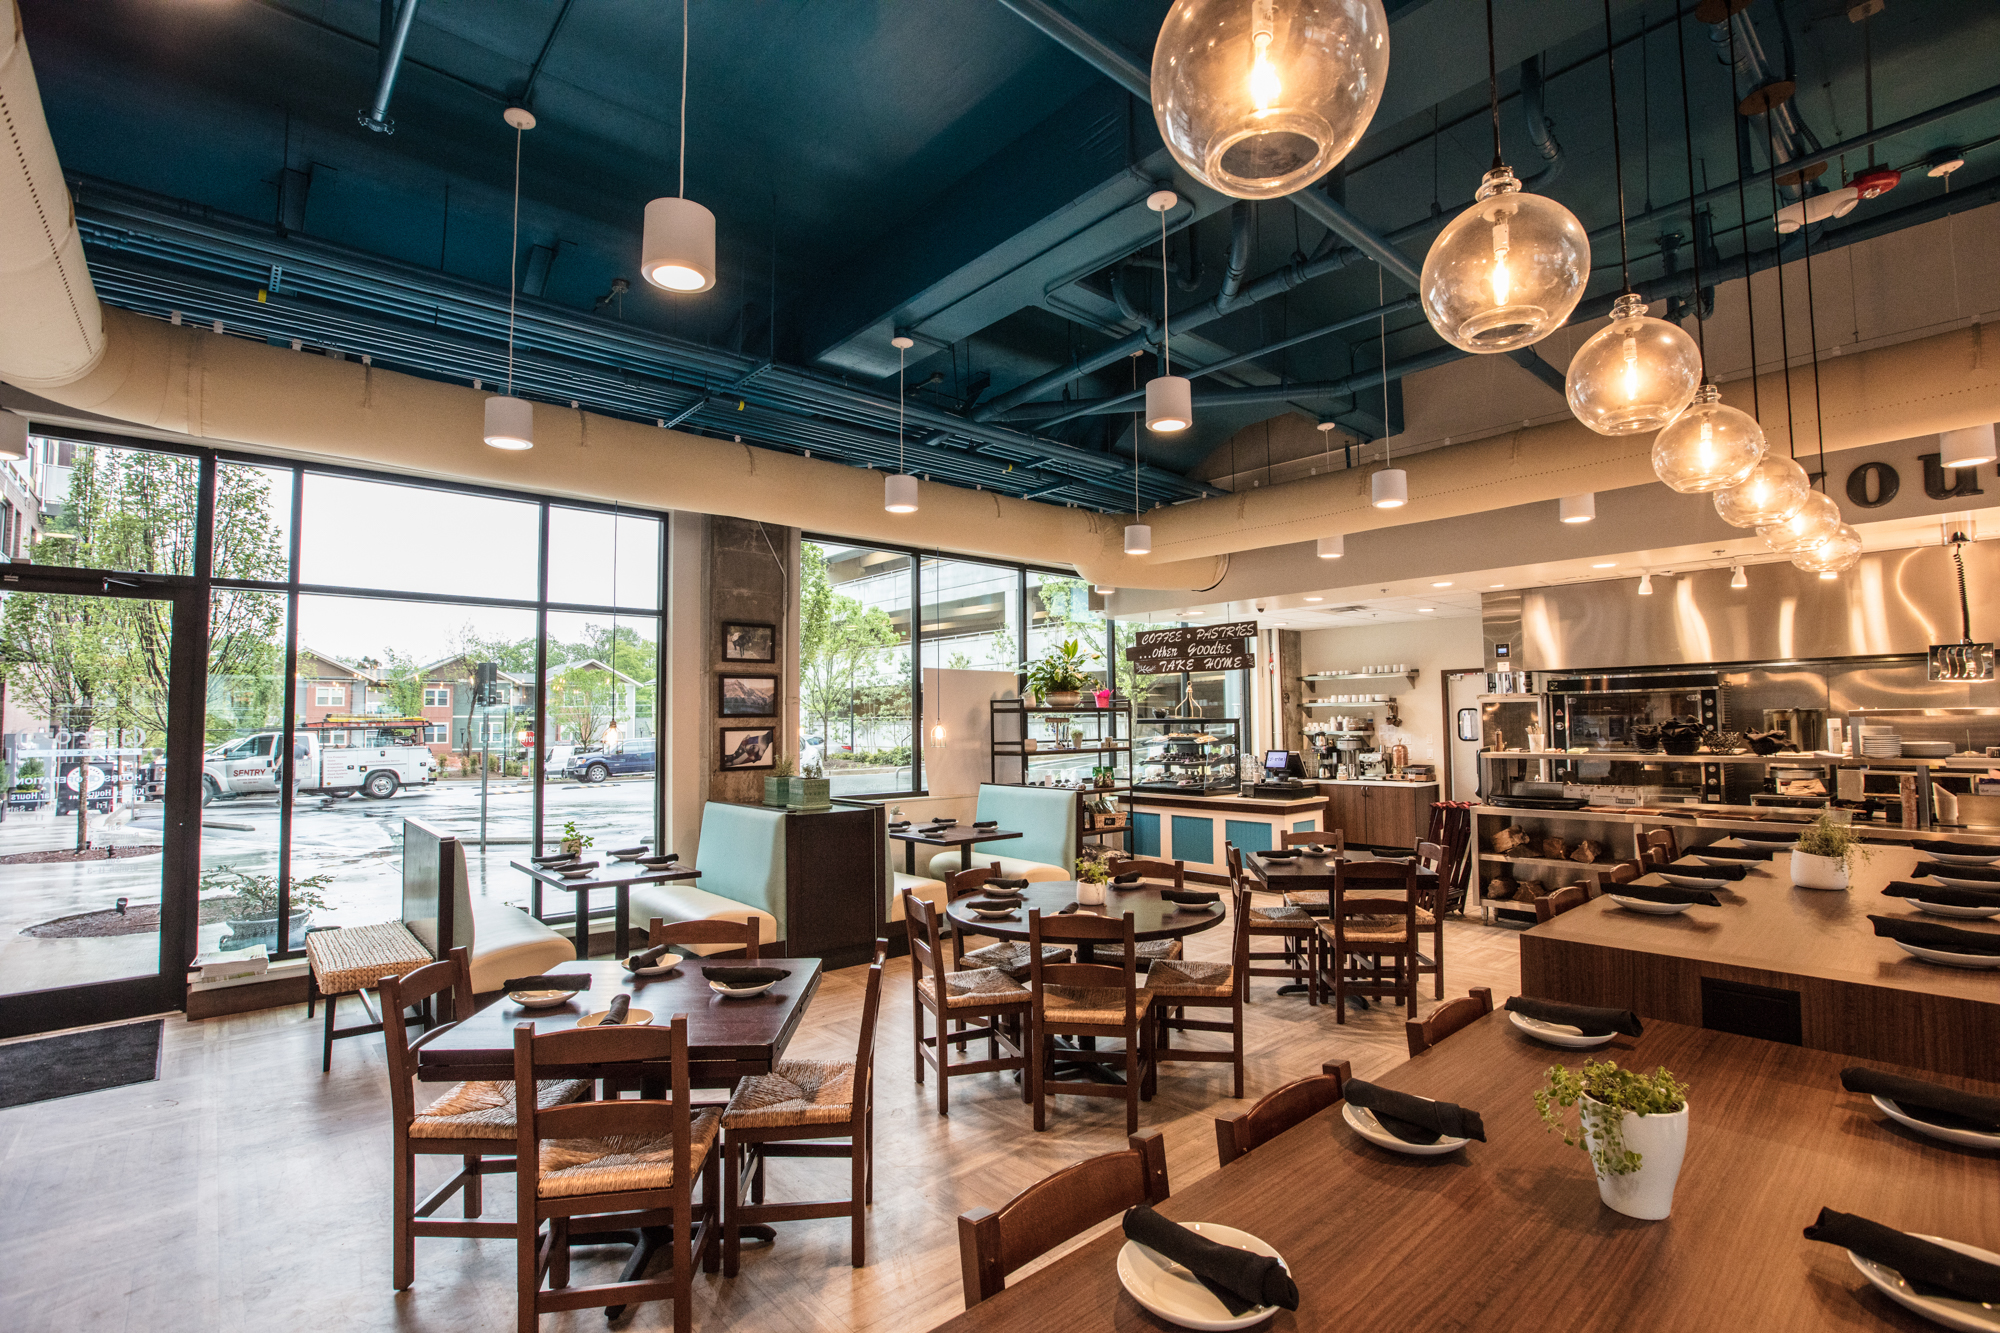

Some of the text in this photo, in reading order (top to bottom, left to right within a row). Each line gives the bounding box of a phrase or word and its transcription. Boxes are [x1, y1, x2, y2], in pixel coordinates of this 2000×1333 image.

[1141, 623, 1254, 645] COFFEE PASTRIES
[1187, 641, 1232, 657] Goodies
[1159, 656, 1243, 672] TAKE HOME
[233, 768, 266, 777] SENTRY
